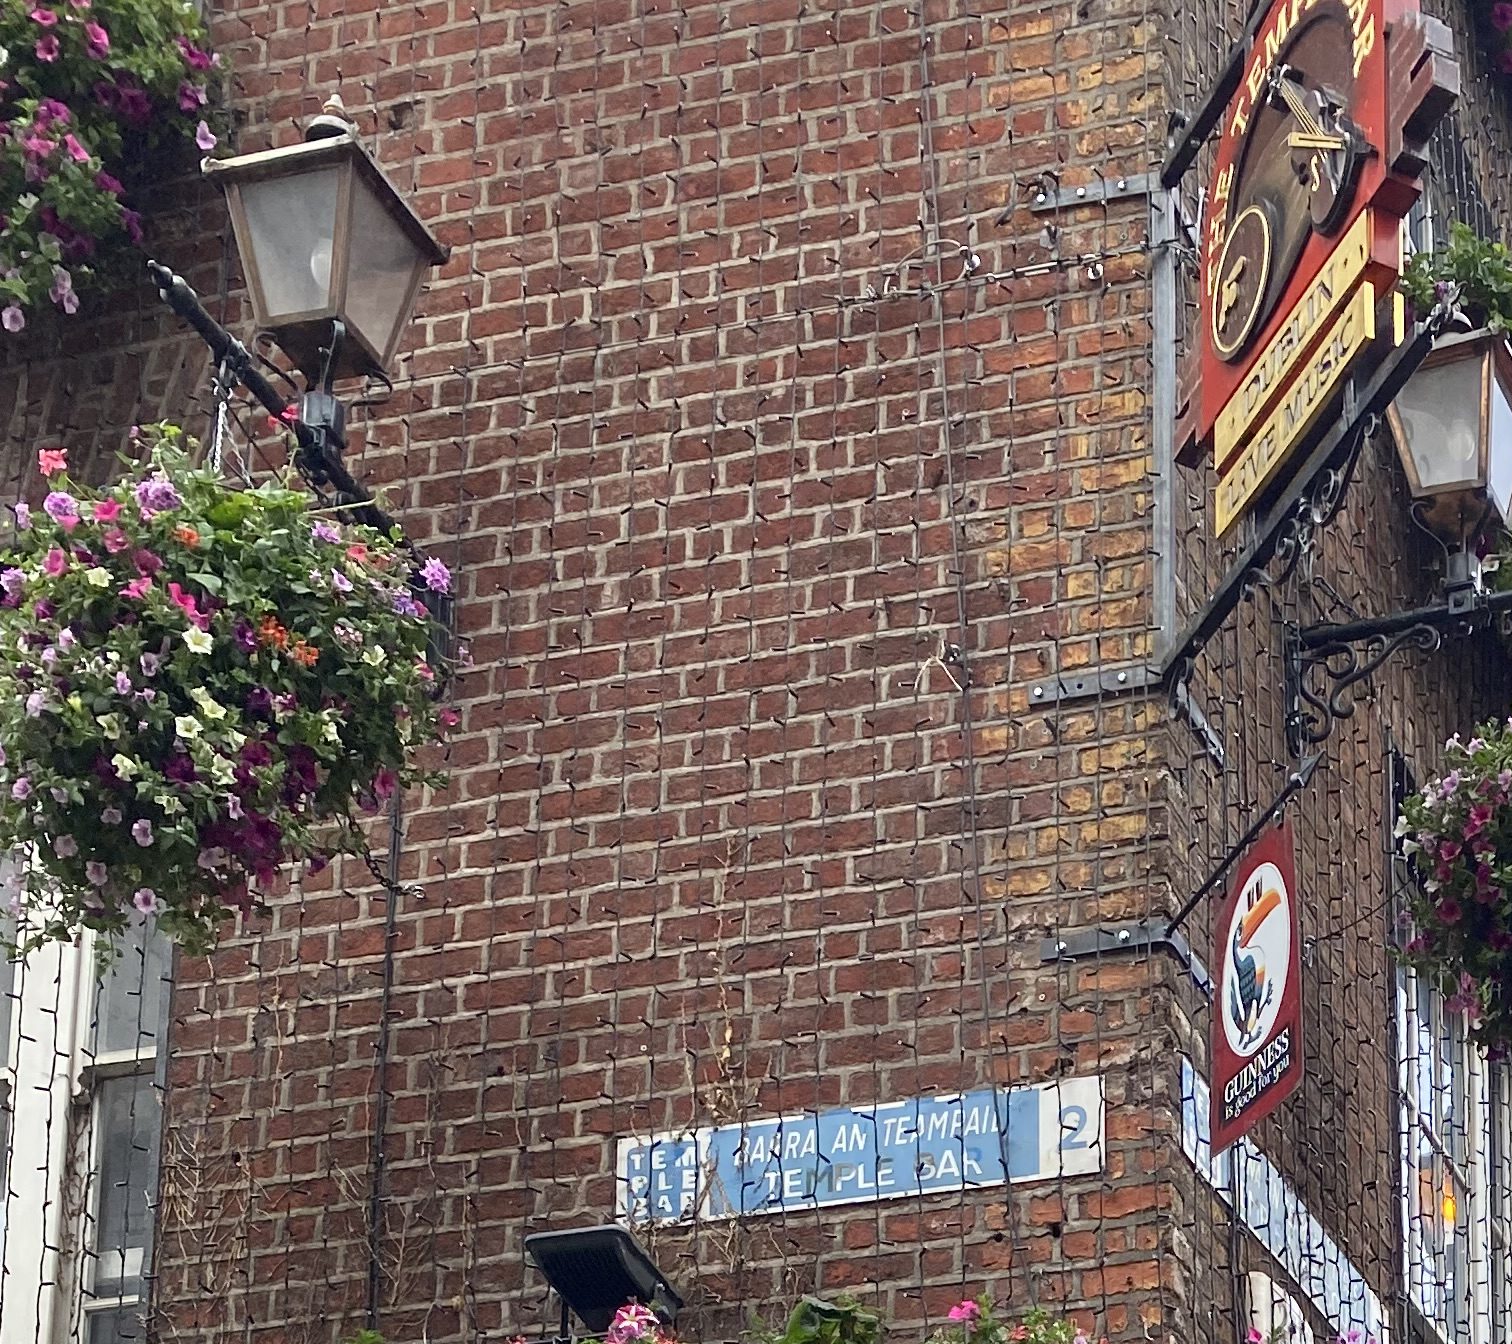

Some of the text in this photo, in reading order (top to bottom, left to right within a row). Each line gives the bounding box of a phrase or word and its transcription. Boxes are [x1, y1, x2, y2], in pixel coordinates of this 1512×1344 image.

[1241, 263, 1336, 417] DUBLIN
[1226, 314, 1355, 509] LIVE MUSIC
[1224, 1027, 1291, 1103] GUINNESS
[1225, 1053, 1291, 1120] is good for you
[831, 1123, 866, 1155] AN
[1058, 1104, 1089, 1150] 2
[764, 1148, 984, 1199] TEMPLE BAR
